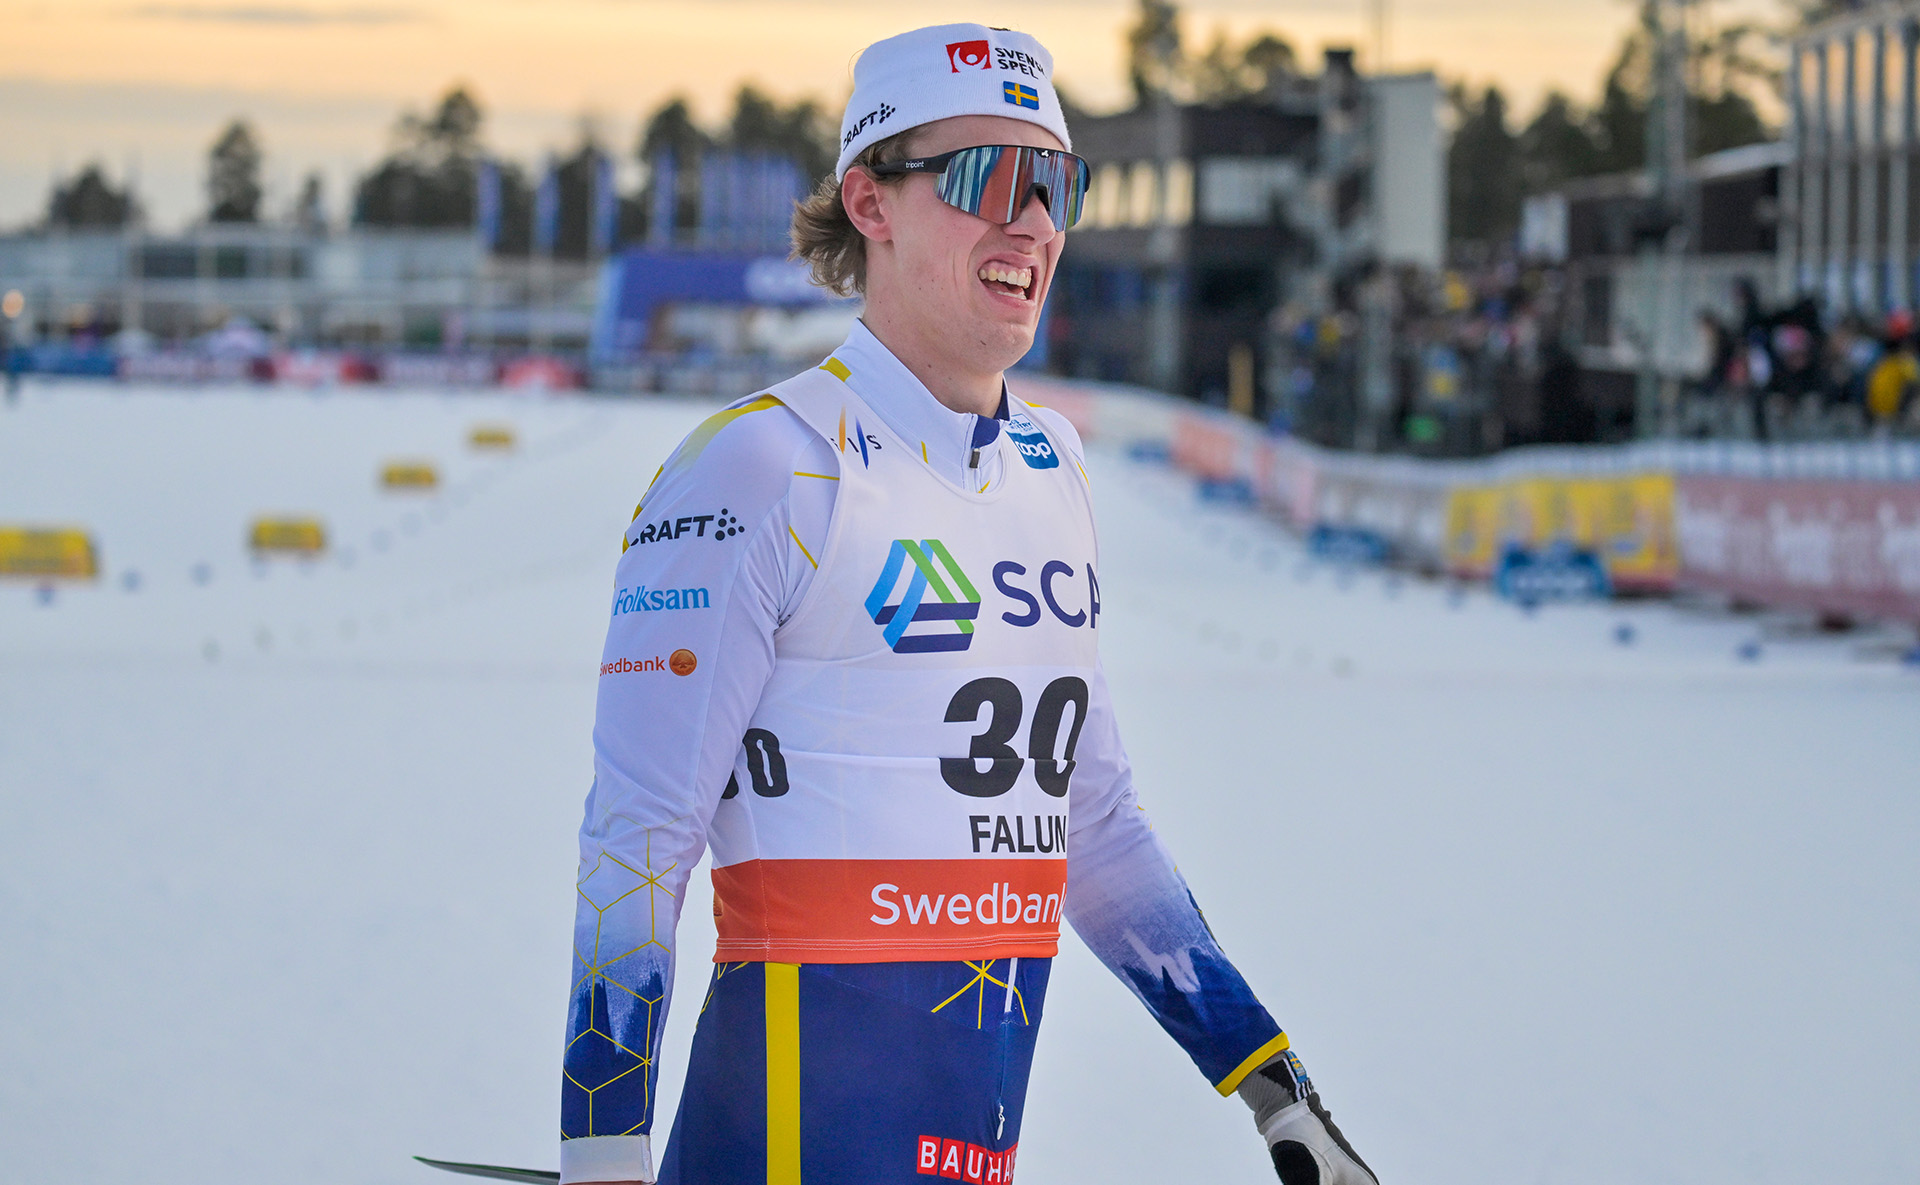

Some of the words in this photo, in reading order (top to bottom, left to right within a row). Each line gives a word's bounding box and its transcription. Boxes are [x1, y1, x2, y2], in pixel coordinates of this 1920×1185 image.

[998, 59, 1039, 80] SPEL
[905, 160, 925, 169] tripoint
[613, 585, 711, 616] Folksam
[992, 560, 1100, 629] SCA
[940, 676, 1089, 797] 30
[721, 728, 790, 799] 0
[969, 815, 1067, 853] FALUN
